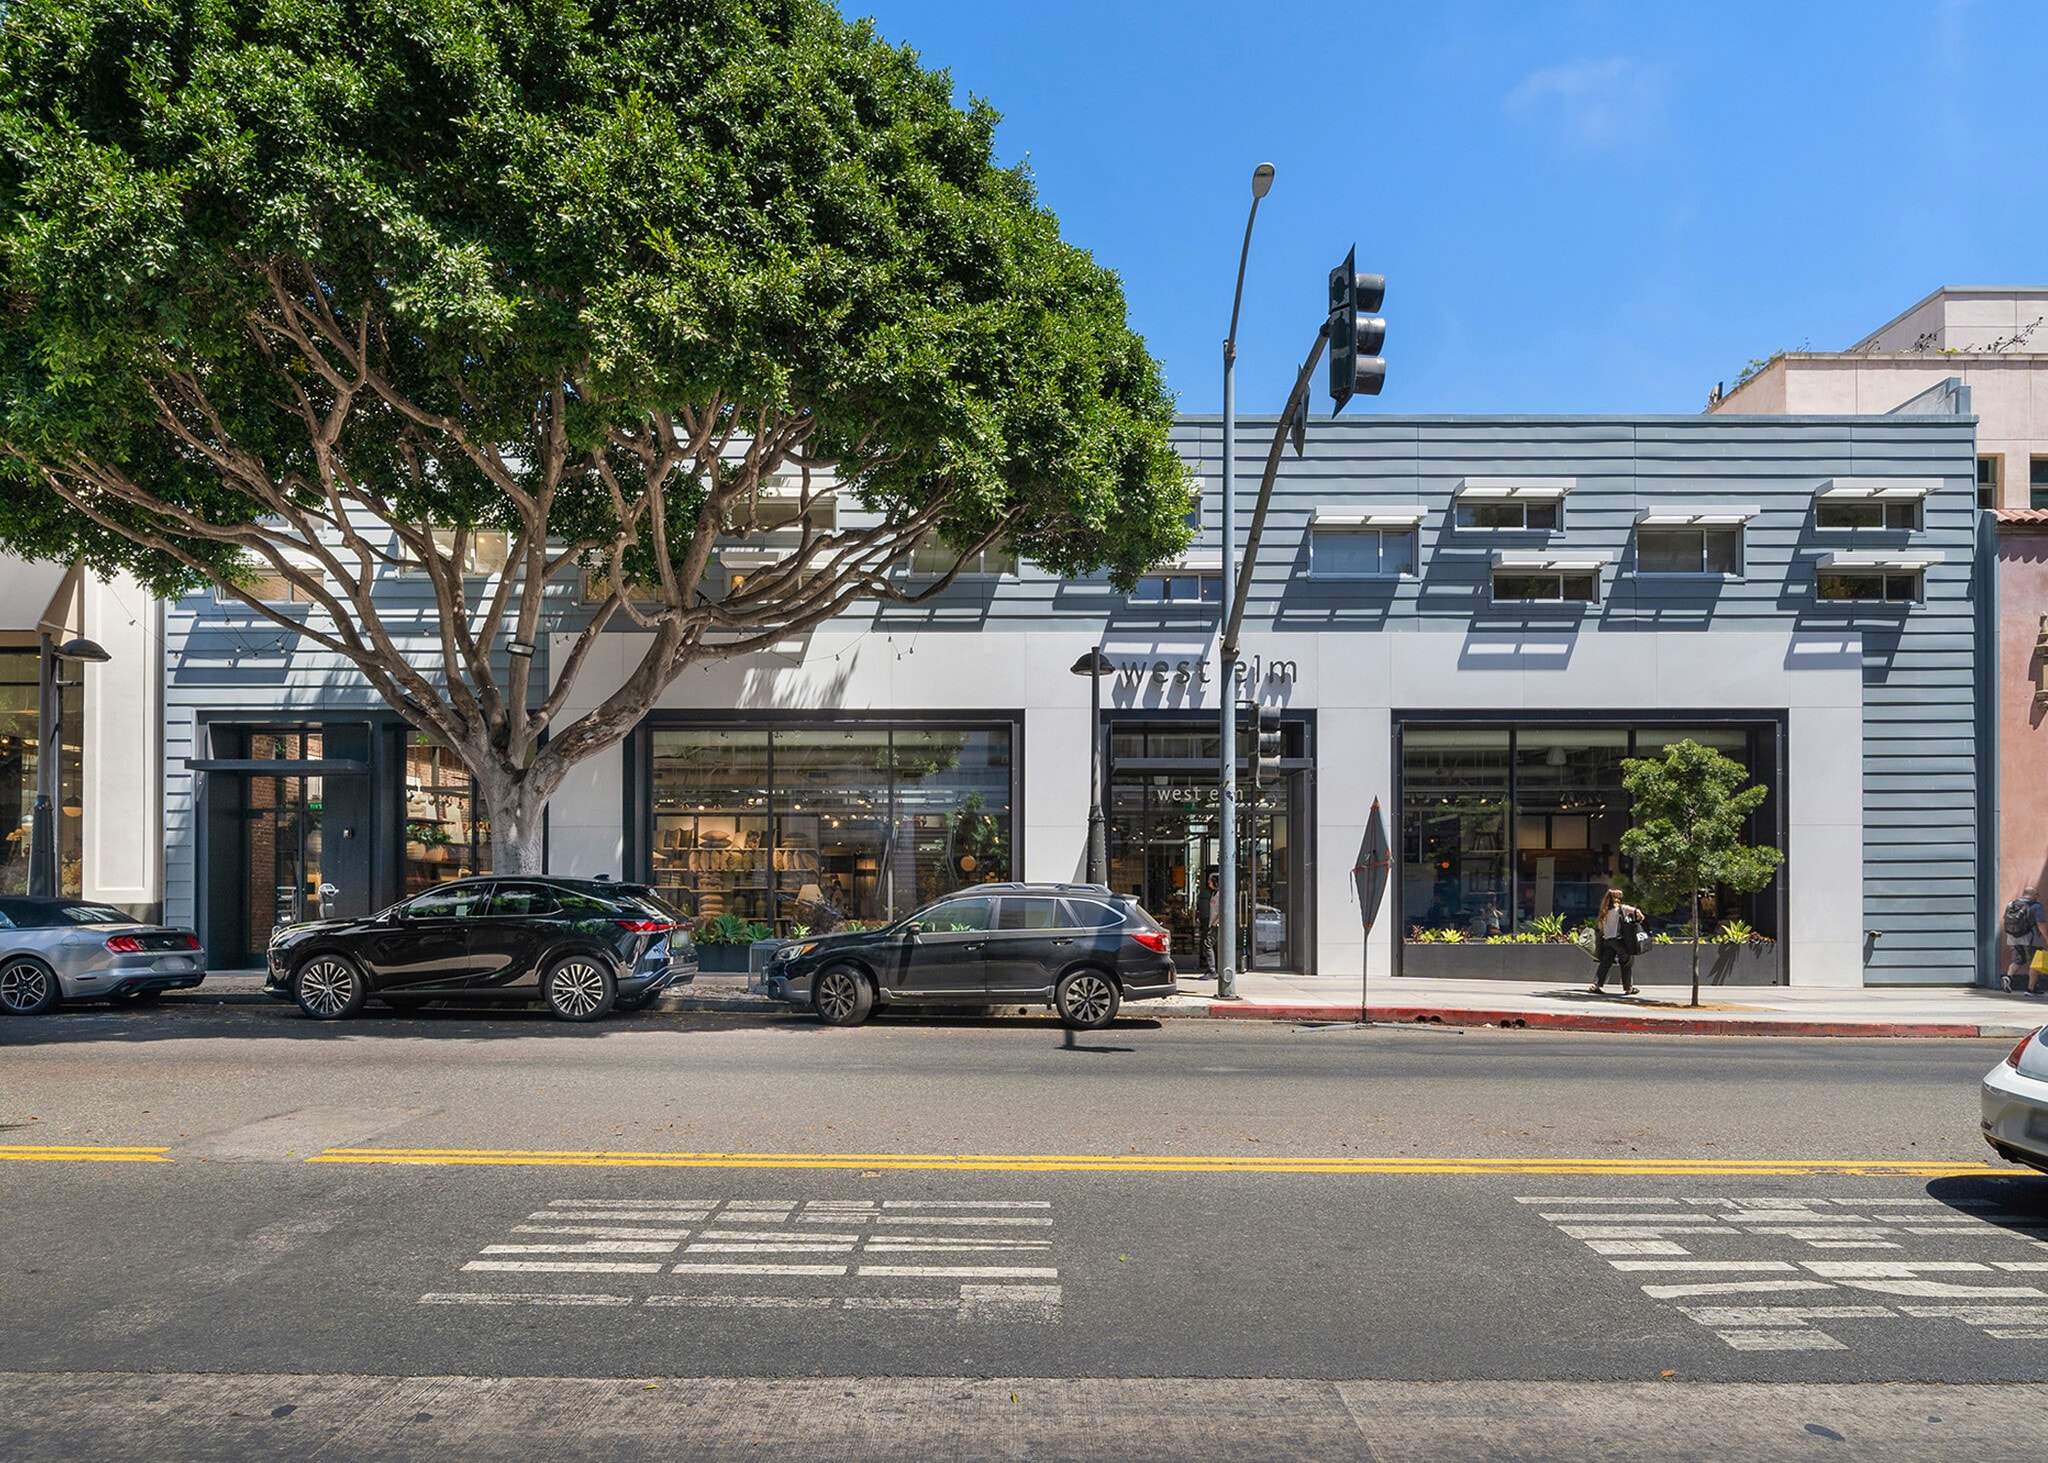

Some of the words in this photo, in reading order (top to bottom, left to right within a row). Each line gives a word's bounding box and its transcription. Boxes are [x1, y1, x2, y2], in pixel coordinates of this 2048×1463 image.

[1121, 654, 1211, 687] west
[1234, 654, 1297, 684] elm
[1157, 786, 1202, 801] west
[1209, 788, 1243, 801] em
